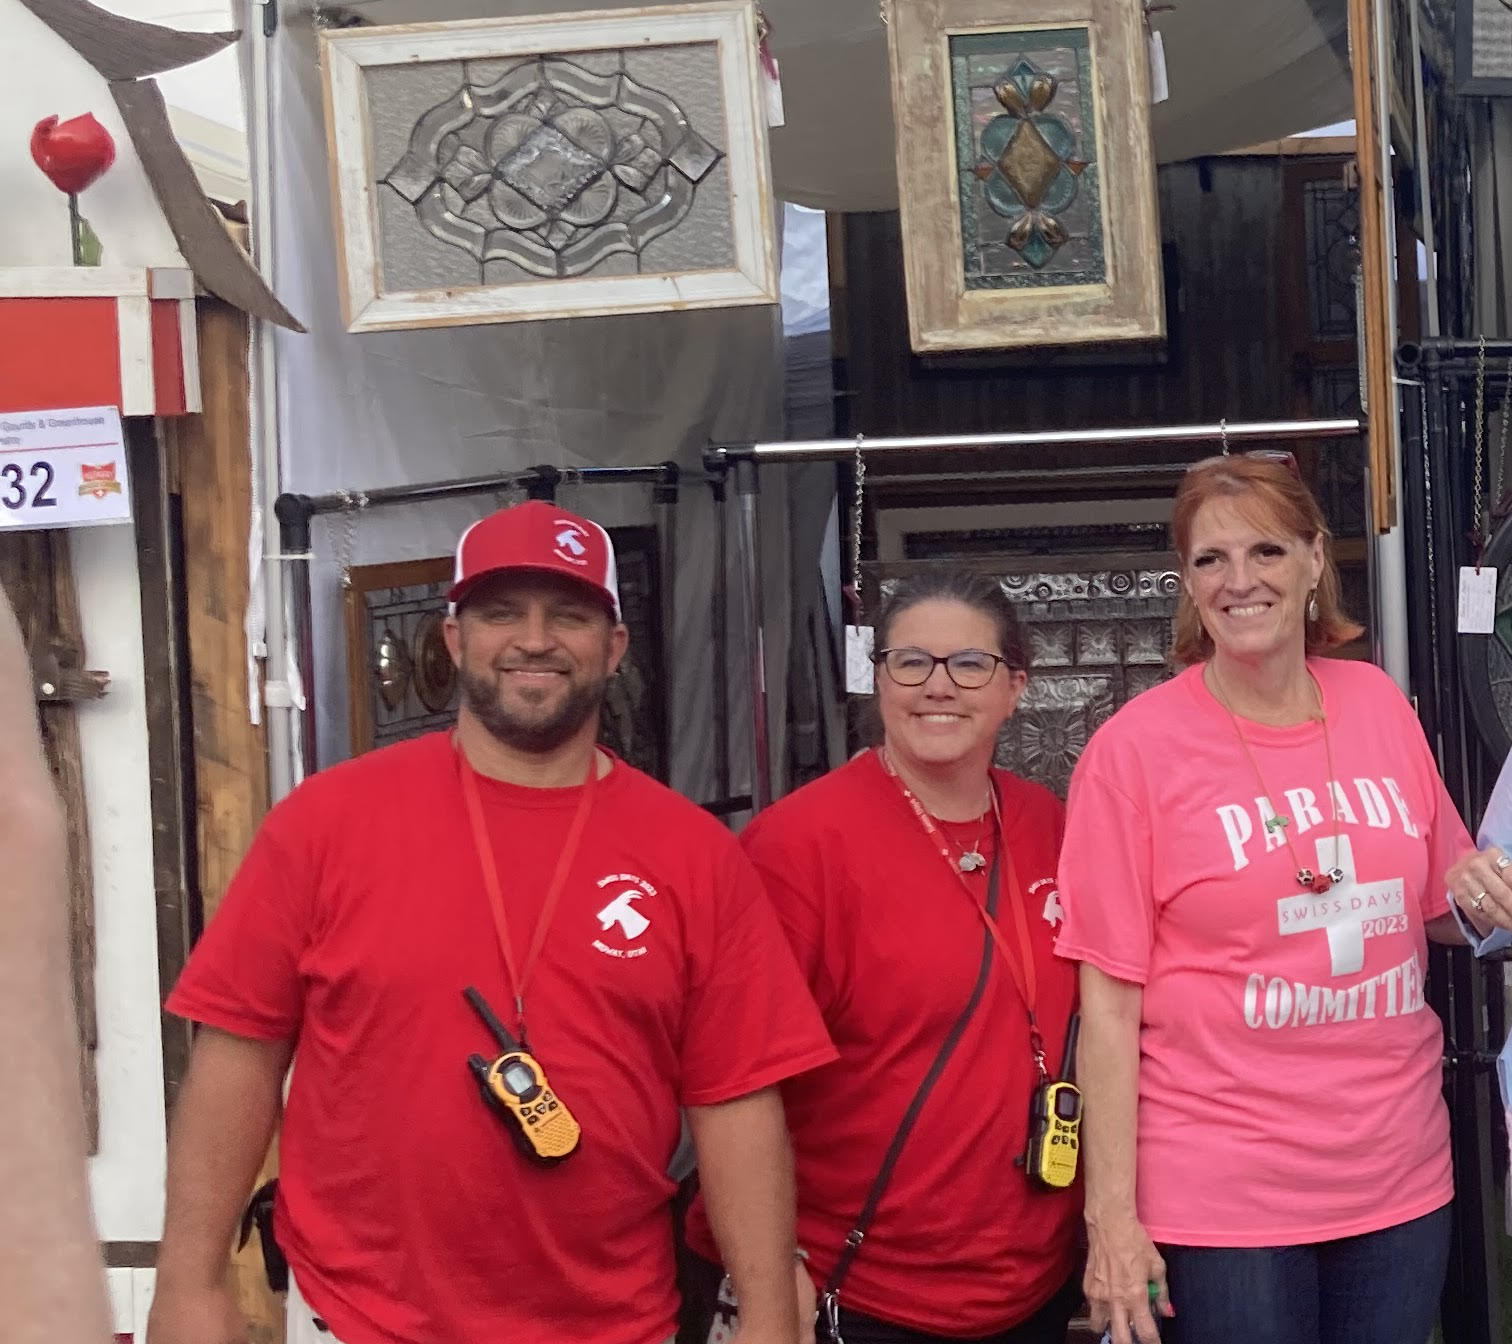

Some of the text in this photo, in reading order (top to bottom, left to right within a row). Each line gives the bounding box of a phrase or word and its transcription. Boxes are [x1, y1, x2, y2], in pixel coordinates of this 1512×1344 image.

[1, 461, 57, 509] 32
[1216, 777, 1419, 871] PARADE
[1282, 890, 1403, 922] SWISS DAYS
[1362, 915, 1408, 938] 2023
